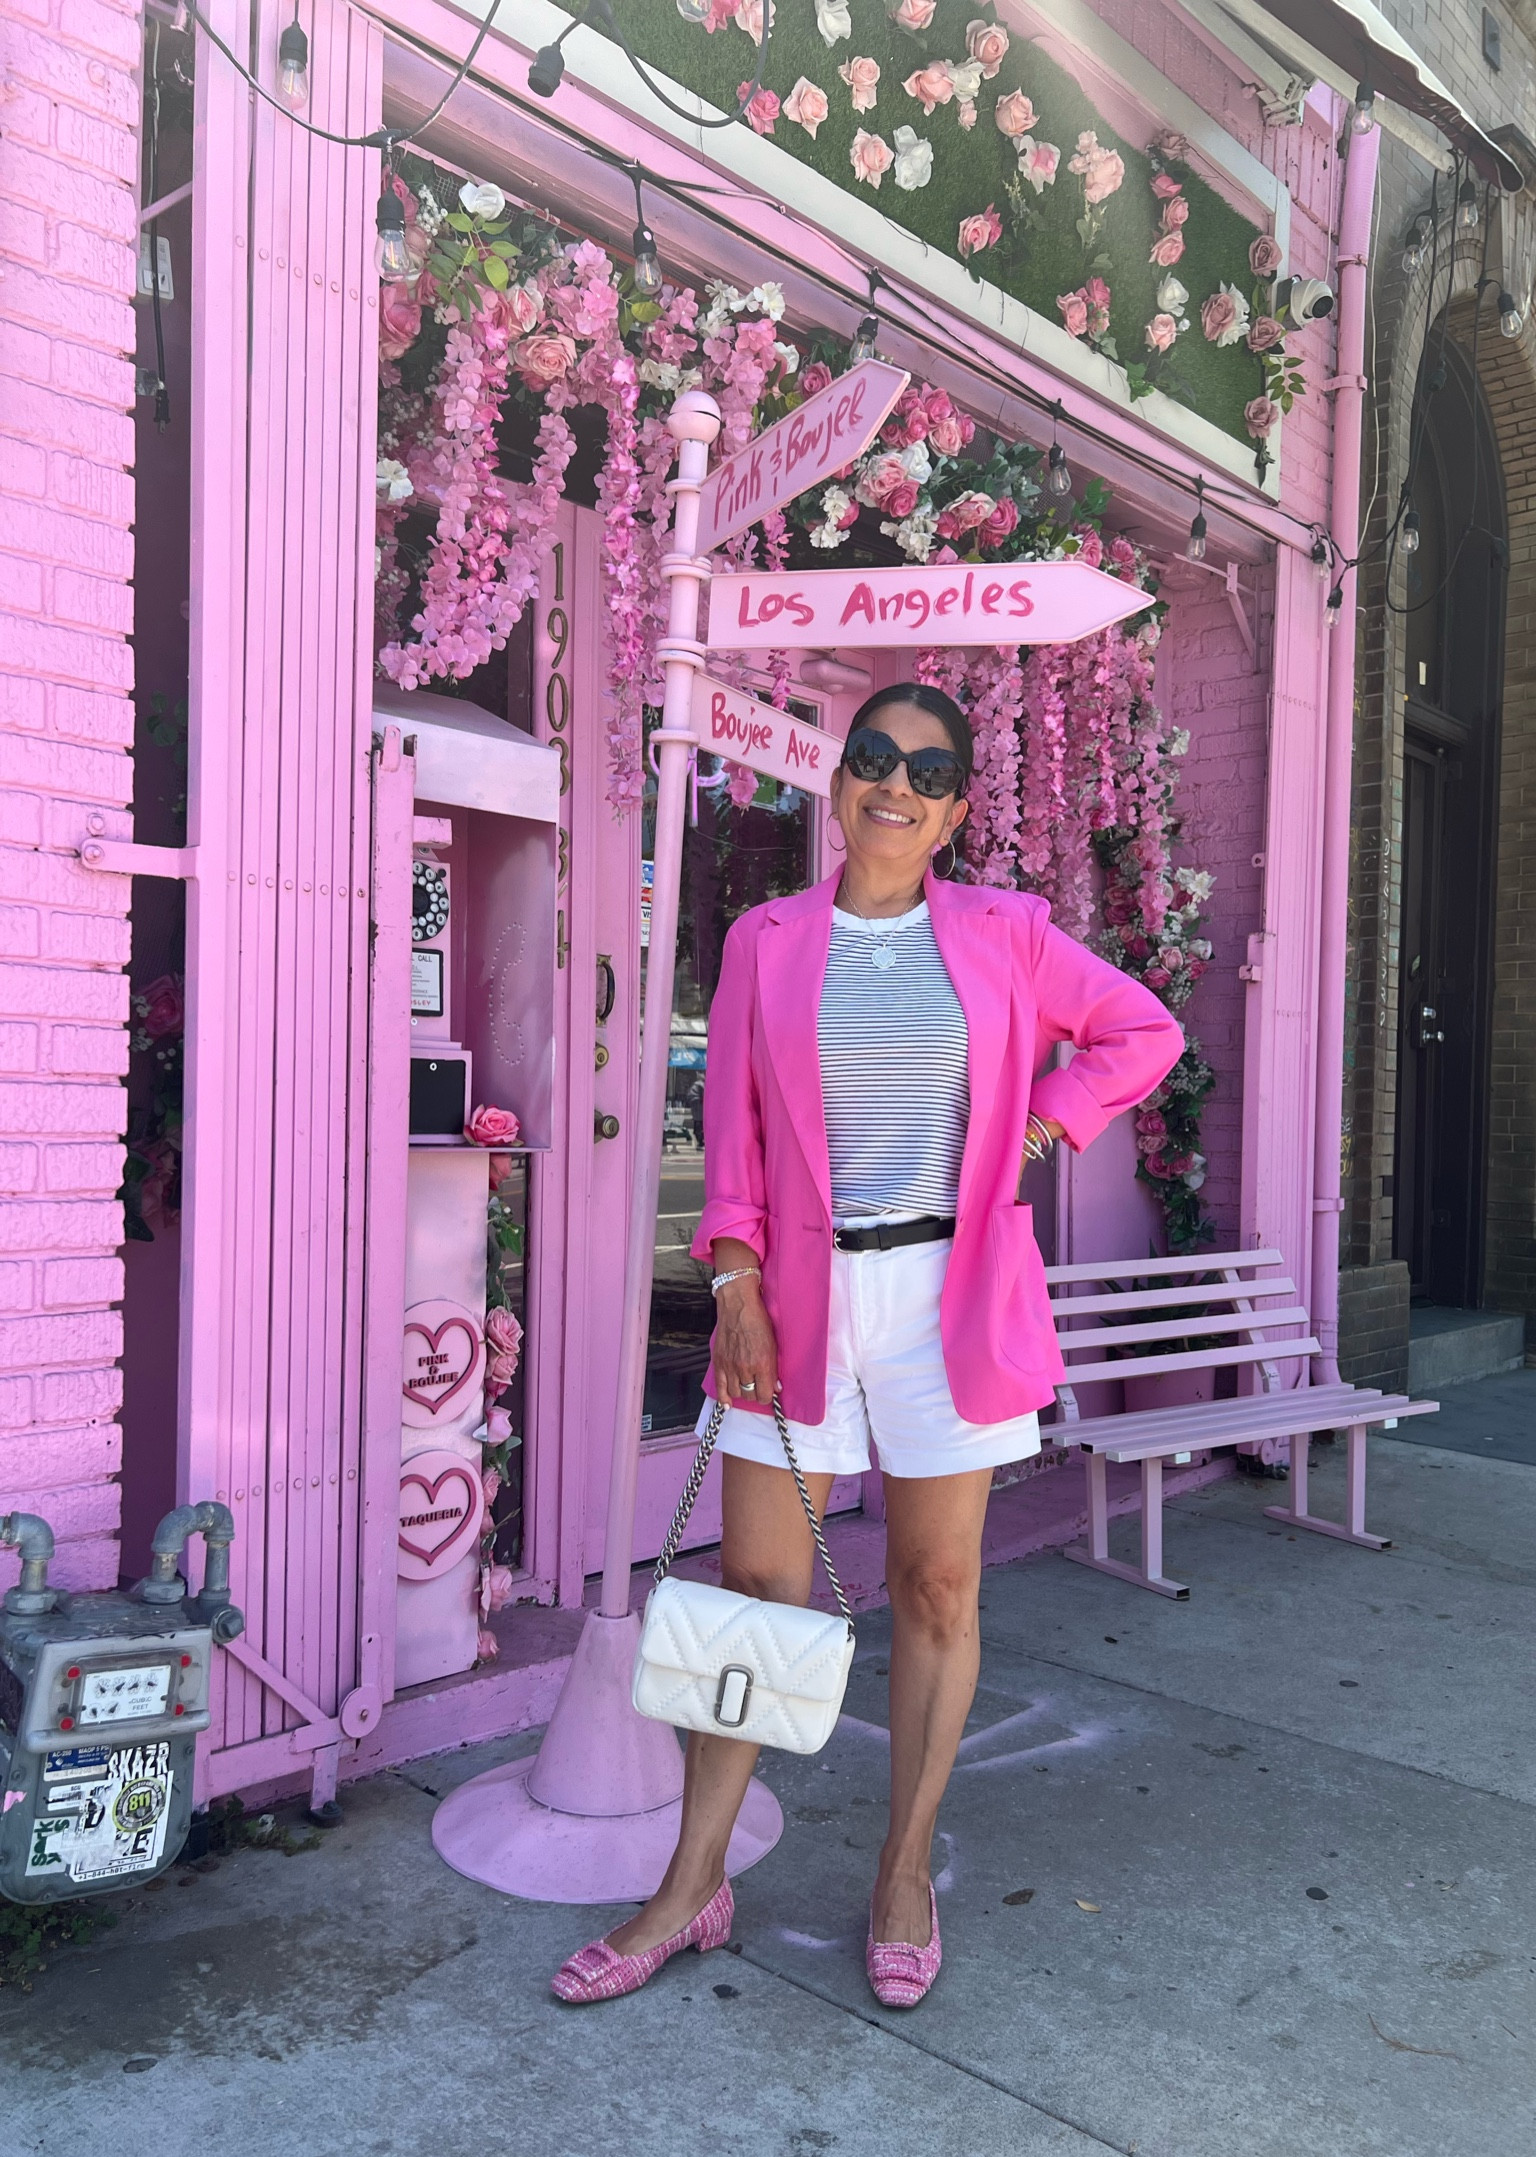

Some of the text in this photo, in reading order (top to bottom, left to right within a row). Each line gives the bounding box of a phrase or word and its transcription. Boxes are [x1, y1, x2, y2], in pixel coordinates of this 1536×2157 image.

[714, 447, 764, 531] Pink
[784, 377, 865, 468] Boujee
[738, 571, 1035, 630] Los Angeles
[711, 692, 821, 769] Boujee Ave
[418, 1353, 449, 1367] PINK
[408, 1372, 459, 1389] BOUJEE
[400, 1507, 463, 1527] TAQUERIA
[129, 1791, 151, 1811] 811
